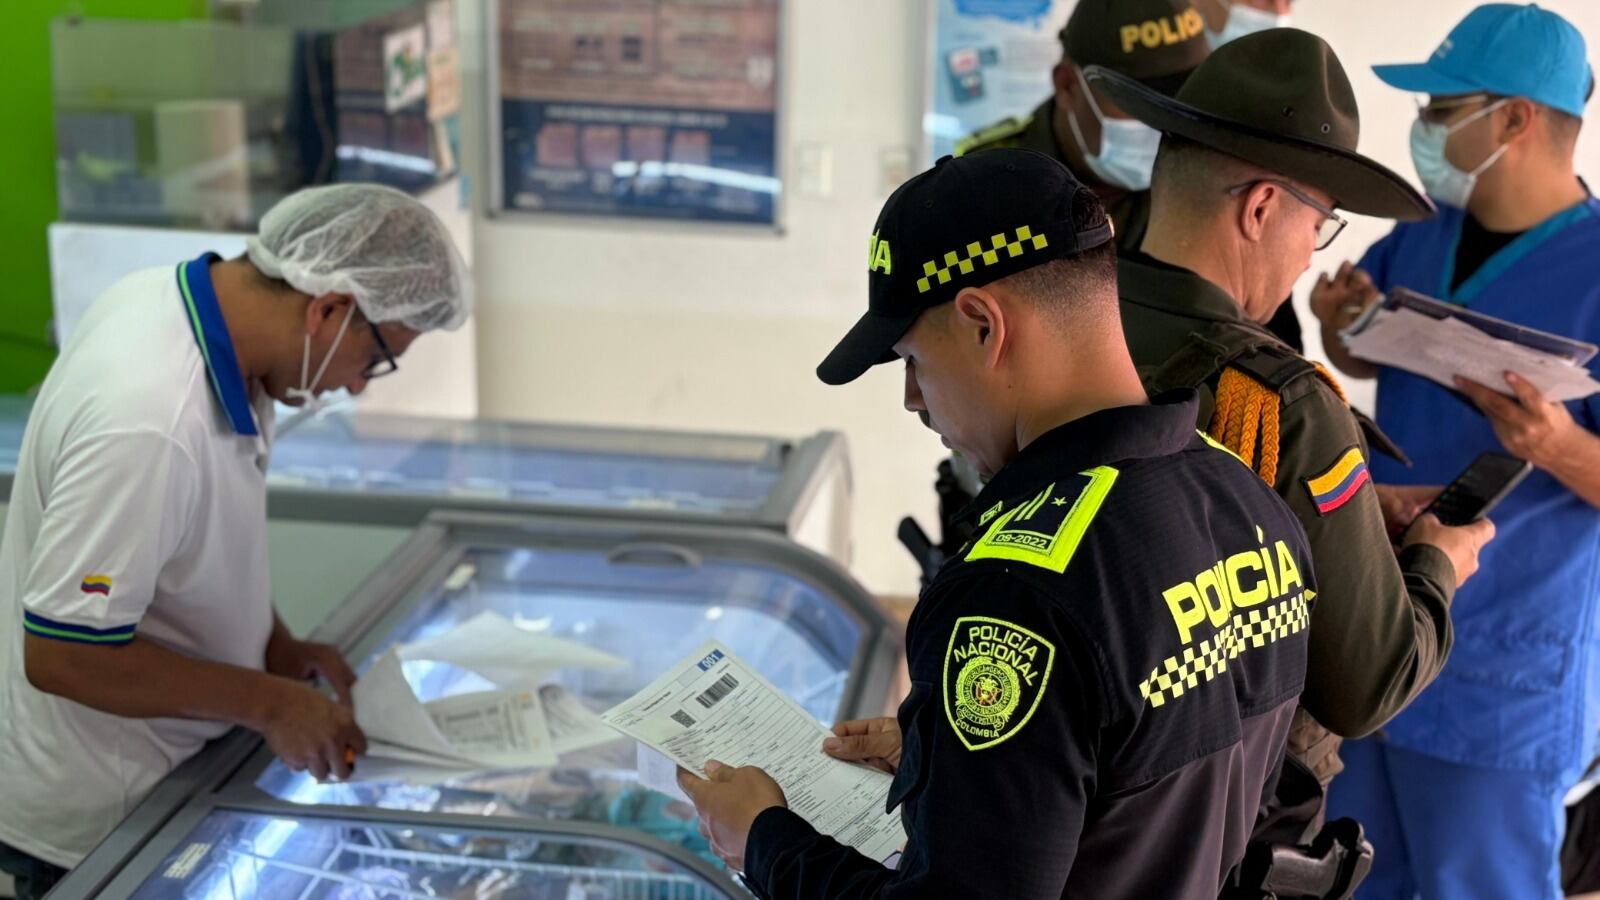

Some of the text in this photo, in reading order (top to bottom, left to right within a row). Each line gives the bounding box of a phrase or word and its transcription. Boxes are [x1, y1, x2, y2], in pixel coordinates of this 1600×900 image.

[969, 625, 1038, 661] POLICÍA
[953, 642, 1038, 686] NACIONAL
[955, 718, 1000, 738] COLOMBIA
